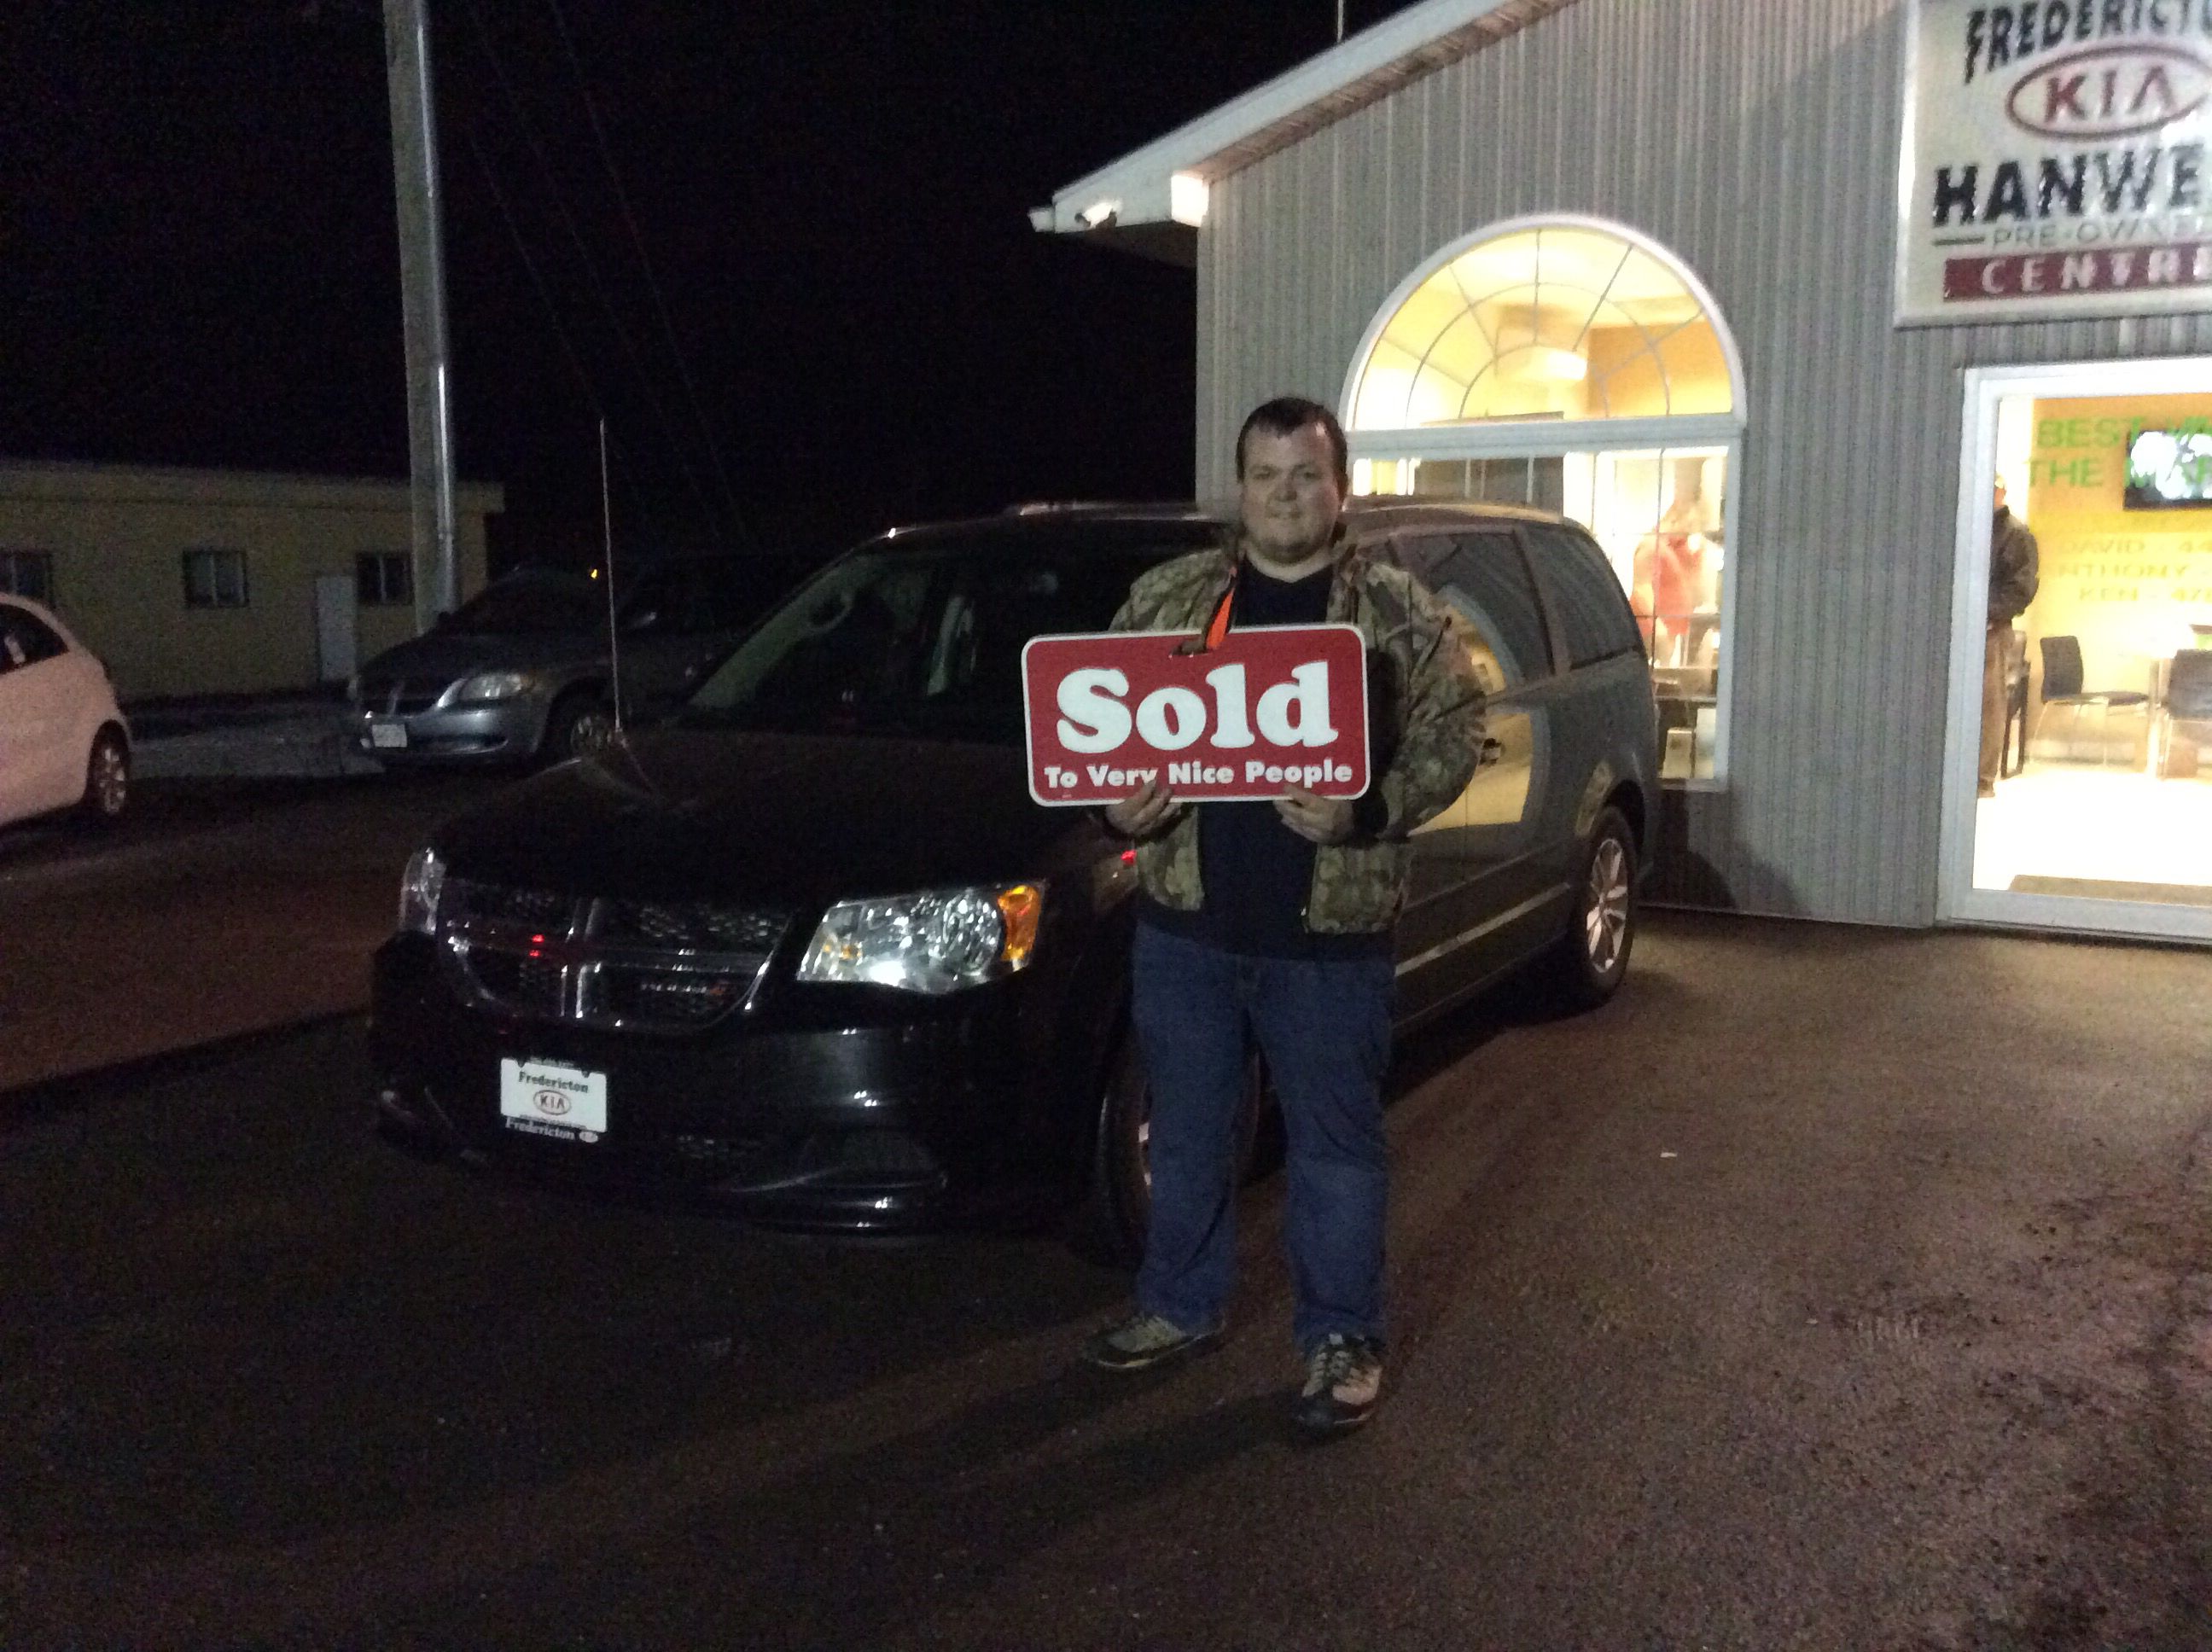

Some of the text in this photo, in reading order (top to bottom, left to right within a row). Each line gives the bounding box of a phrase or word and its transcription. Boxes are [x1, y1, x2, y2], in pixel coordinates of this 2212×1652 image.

[2045, 65, 2177, 124] KIA
[2029, 457, 2104, 488] THE
[1057, 660, 1339, 753] Sold
[1044, 758, 1353, 788] To Very Nice People
[518, 1071, 589, 1093] Fredericton
[539, 1094, 566, 1110] KIA
